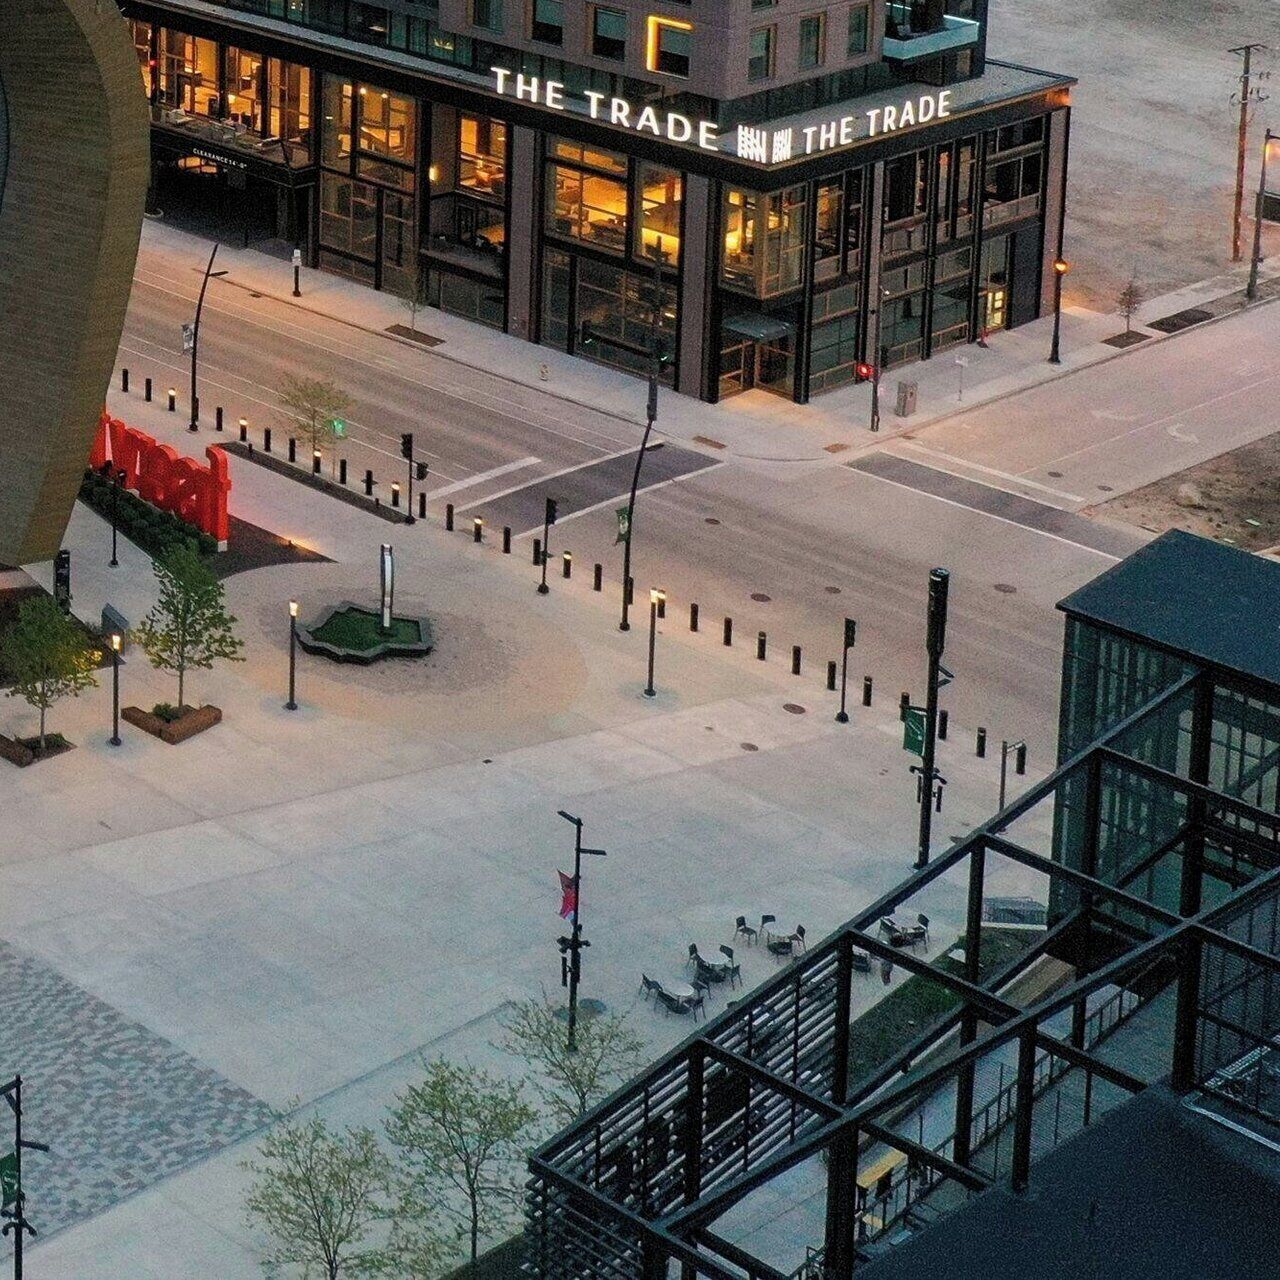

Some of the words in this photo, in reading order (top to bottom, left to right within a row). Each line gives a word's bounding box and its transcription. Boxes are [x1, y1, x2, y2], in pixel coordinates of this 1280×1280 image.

[490, 66, 565, 110] THE
[584, 90, 720, 151] TRADE
[803, 118, 854, 155] THE
[866, 90, 951, 136] TRADE
[192, 147, 228, 164] CLEARANCE
